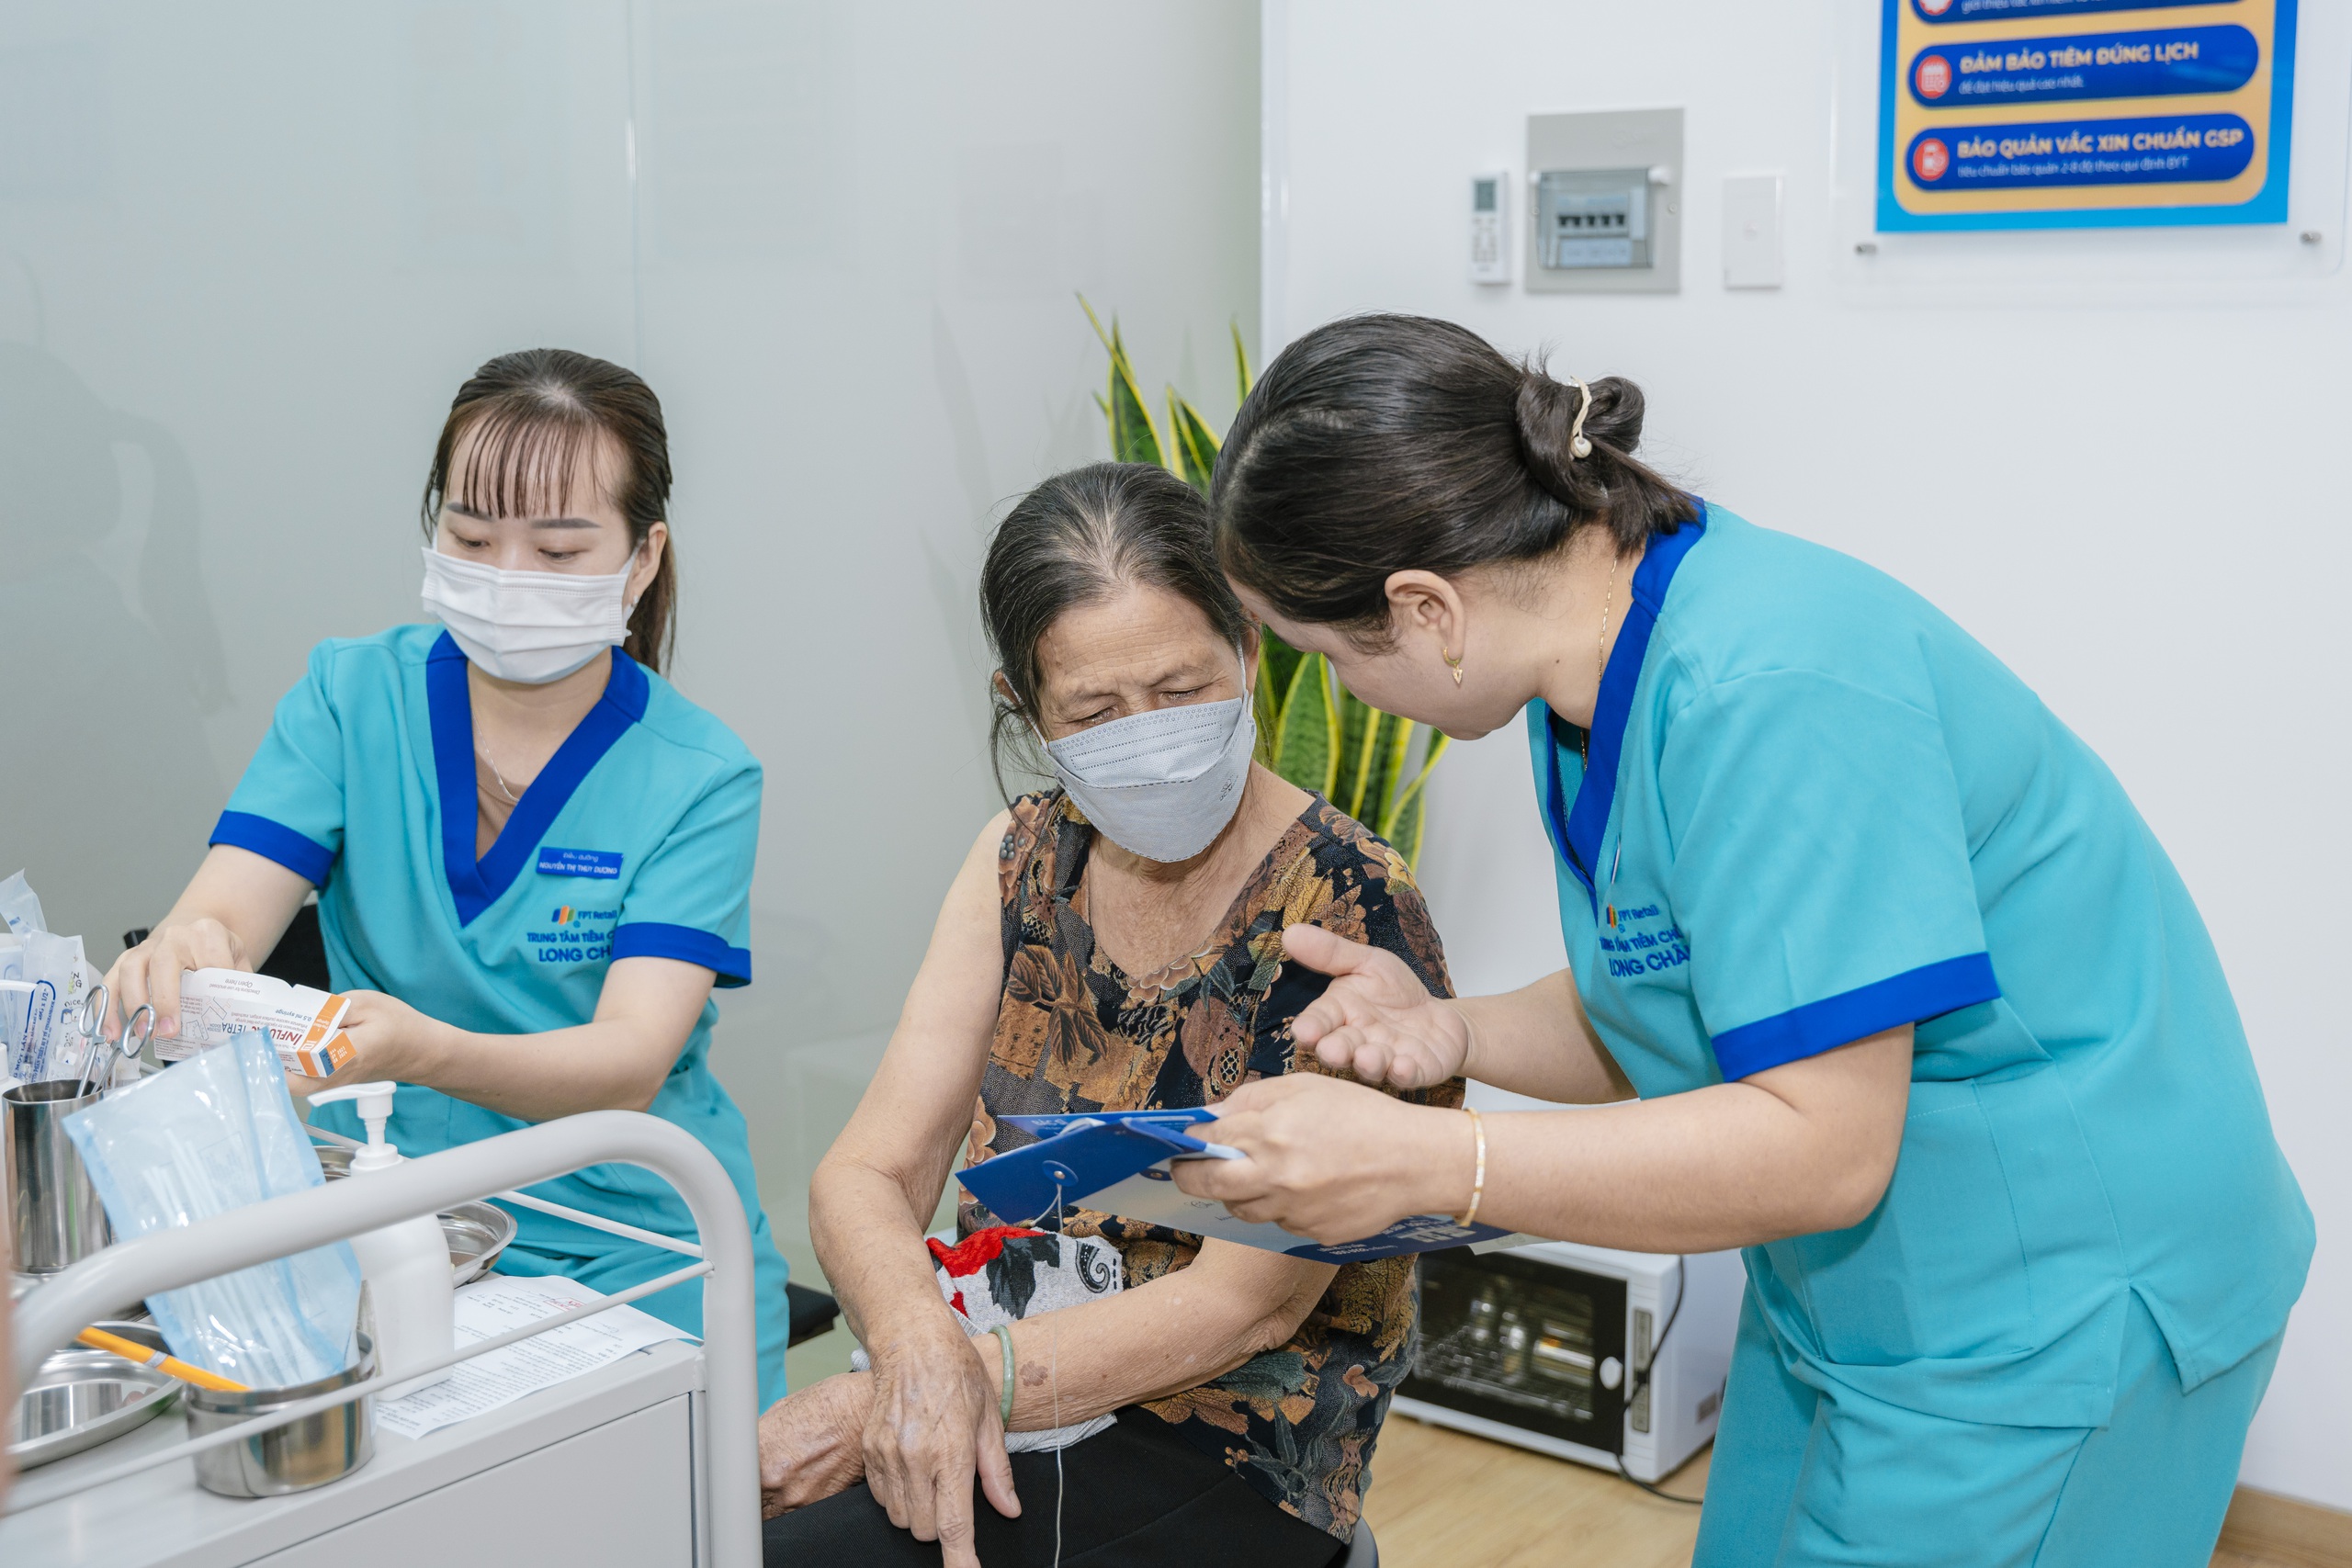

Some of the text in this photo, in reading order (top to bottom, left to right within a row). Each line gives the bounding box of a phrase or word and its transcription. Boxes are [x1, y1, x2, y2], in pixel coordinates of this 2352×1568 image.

[1960, 40, 2199, 73] ĐẢM BẢO TIÊM ĐÚNG LỊCH
[1957, 125, 2245, 159] BẢO QUẢN VẮC XIN CHUẨN GSP
[577, 908, 617, 919] FPT Retail
[1618, 904, 1659, 921] FPT Retail
[526, 931, 557, 942] TRUNG
[559, 930, 581, 943] TÂM
[582, 930, 605, 943] TIÊM
[1629, 931, 1659, 951] TIÊM
[538, 944, 611, 963] LONG CH
[1608, 942, 1690, 977] LONG CHÂ
[221, 1021, 245, 1033] TETRA
[251, 1026, 302, 1045] INFLUC
